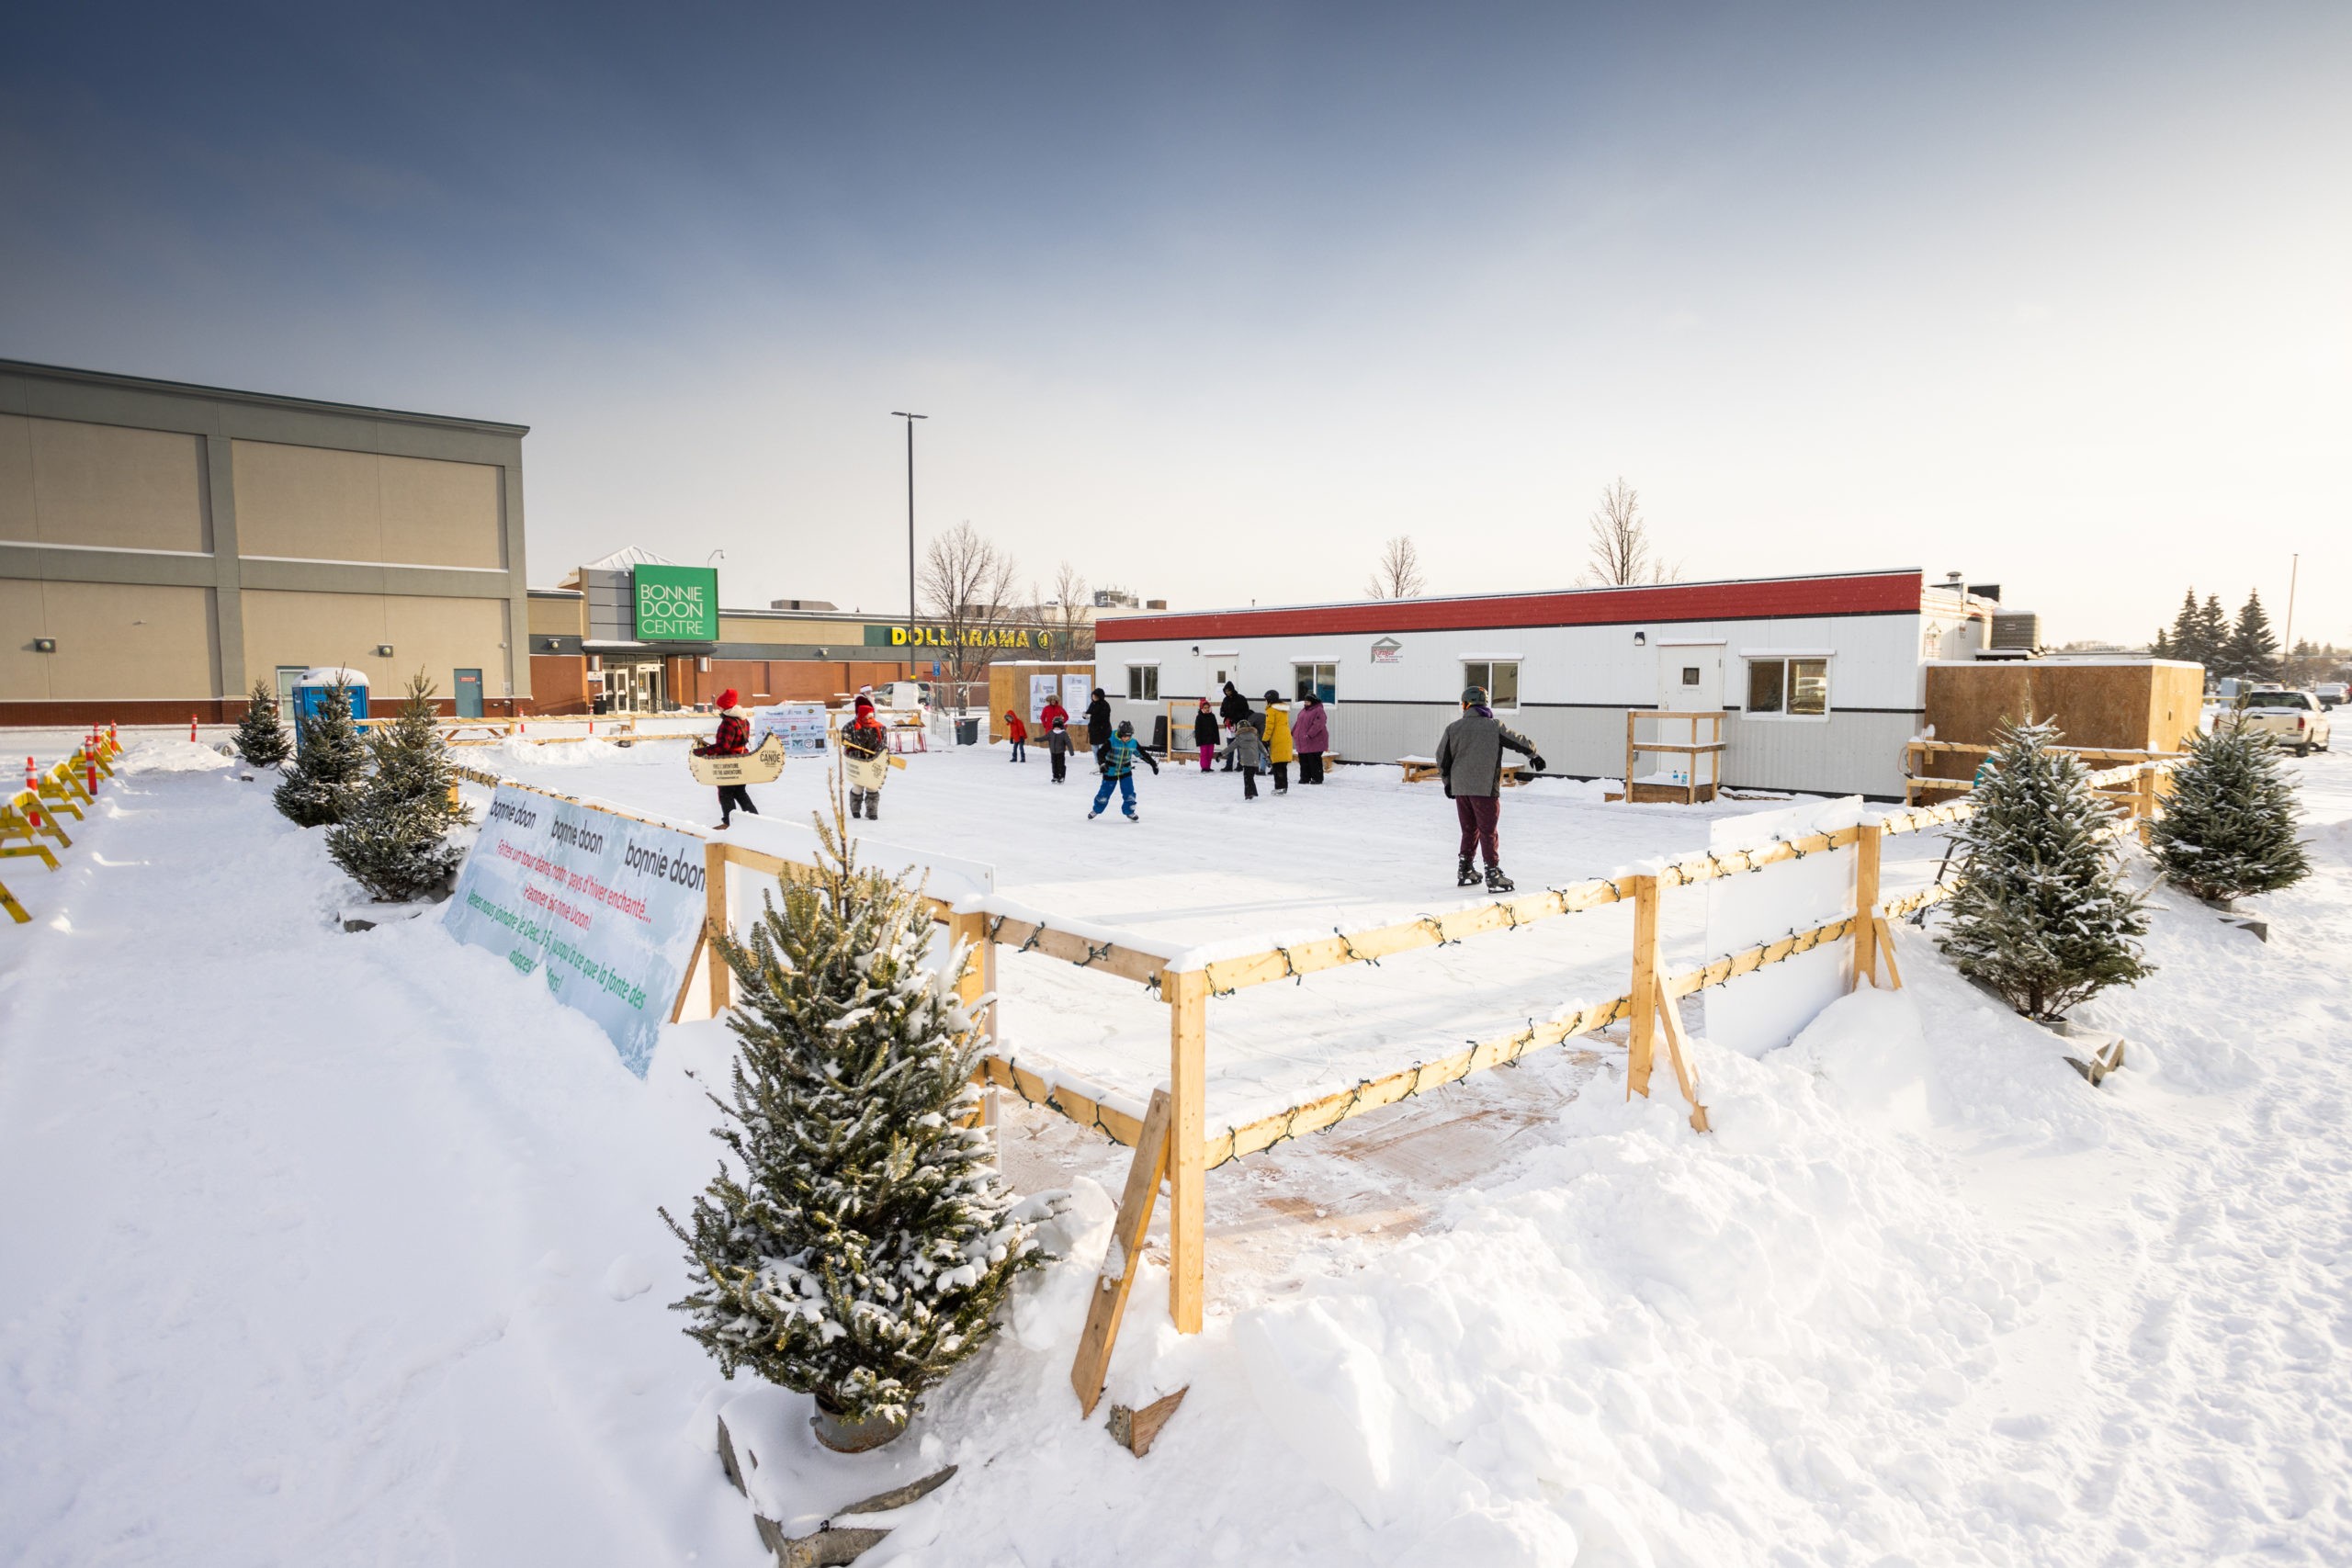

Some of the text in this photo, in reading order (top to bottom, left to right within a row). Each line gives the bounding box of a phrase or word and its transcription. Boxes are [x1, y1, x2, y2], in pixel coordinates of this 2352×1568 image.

[640, 584, 704, 602] BONNIE
[640, 600, 704, 618] DOON
[641, 619, 704, 635] CENTRE
[891, 626, 1030, 648] DOLLARAMA
[490, 796, 537, 829] bonnie doon
[551, 815, 603, 855] bonnie doon
[496, 839, 513, 859] Faites
[512, 849, 522, 862] un
[521, 850, 536, 869] tour
[535, 854, 551, 876] dans
[567, 871, 582, 894] pays
[625, 838, 706, 892] bonnie doon
[570, 904, 594, 931] Doon!
[481, 899, 496, 917] nous
[491, 903, 519, 930] joindre
[516, 915, 526, 933] le
[574, 953, 584, 971] ce
[582, 958, 599, 979] que
[596, 962, 608, 985] la
[603, 967, 630, 999] fonte
[628, 983, 647, 1010] des
